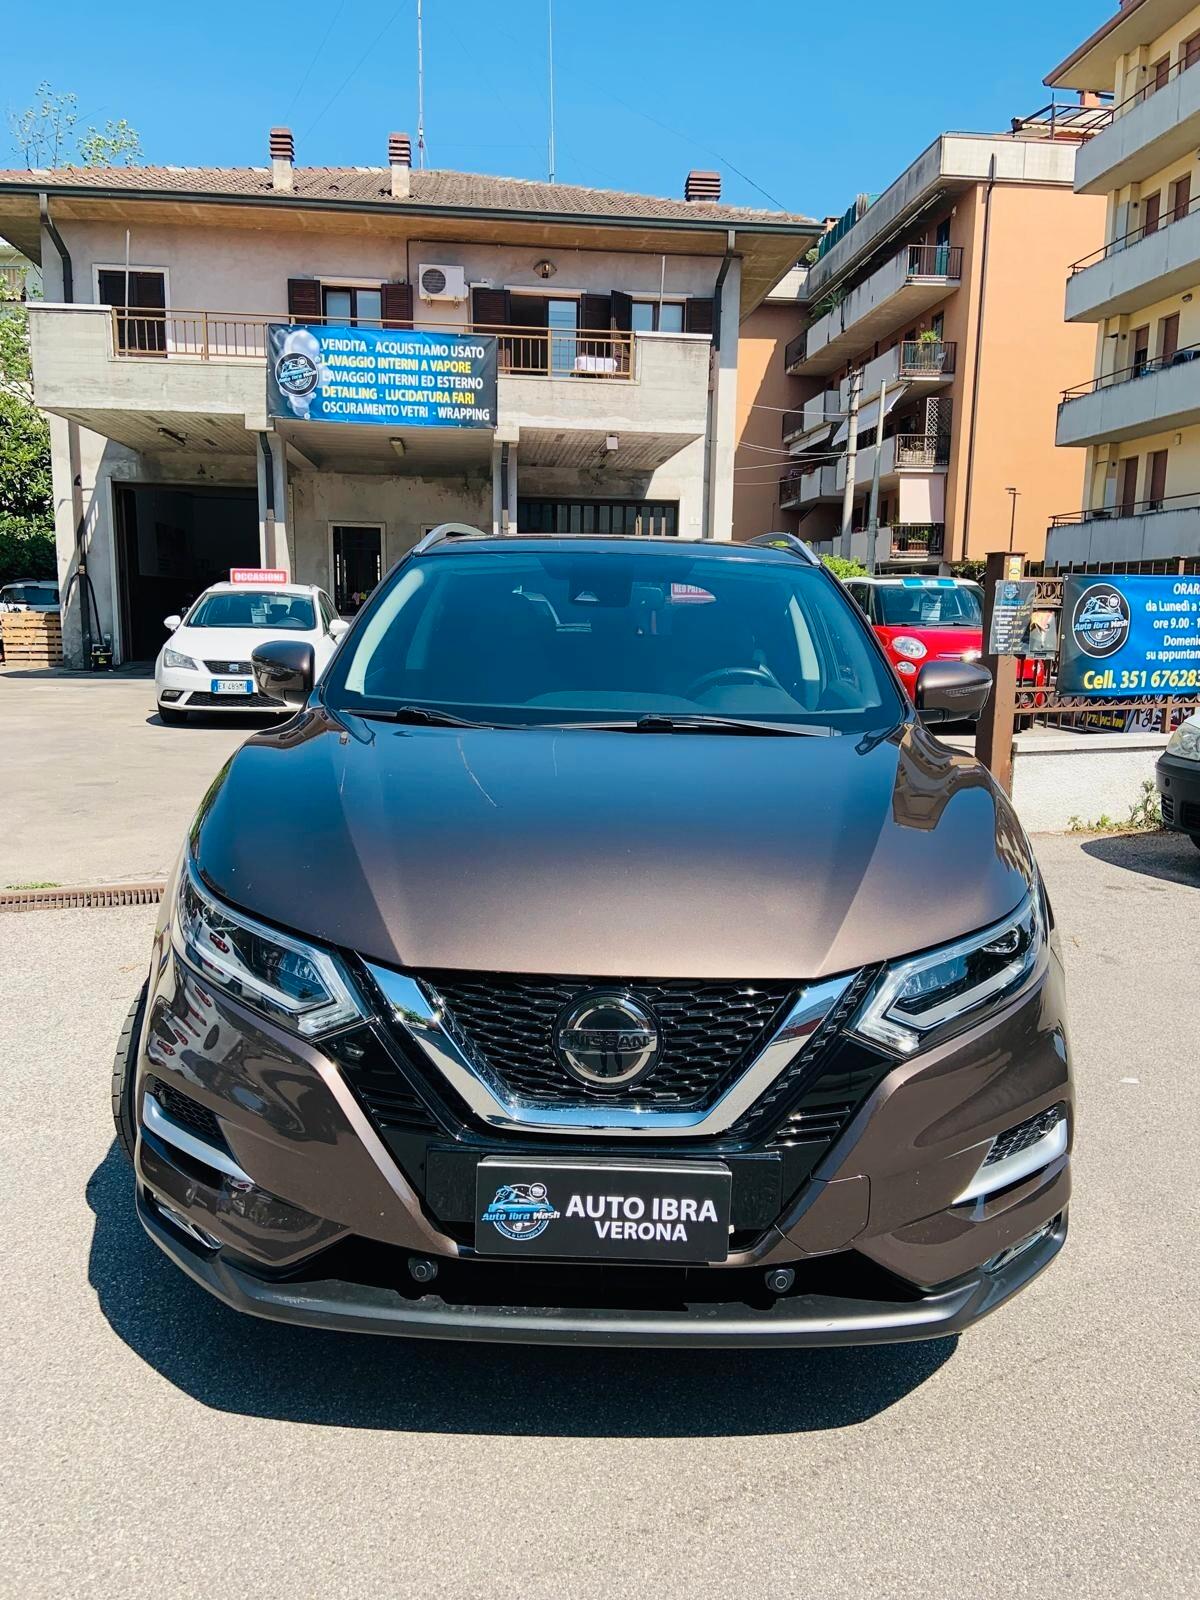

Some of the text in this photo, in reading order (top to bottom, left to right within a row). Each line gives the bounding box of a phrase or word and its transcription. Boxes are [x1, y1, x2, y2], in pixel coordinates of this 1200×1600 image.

[321, 338, 367, 352] VENDITA
[375, 341, 449, 357] ACQUISTIAMO
[450, 345, 485, 358] USATO
[321, 354, 472, 374] LAVAGGIO INTERNI A VAPORE
[322, 370, 484, 390] LAVAGGIO INTERNI ED ESTERNO
[322, 385, 378, 400] DETAILING
[385, 388, 450, 404] LUCIDATURA
[452, 392, 474, 404] FARI
[322, 401, 400, 416] OSCURAMENTO
[400, 405, 428, 418] VETRI
[437, 406, 490, 420] WRAPPING
[234, 572, 285, 582] OCCASIONE
[1173, 583, 1200, 595] ORAR
[1145, 600, 1157, 612] da
[1158, 600, 1190, 612] Lunedì
[1191, 603, 1197, 612] a
[1074, 622, 1092, 631] Auto
[1110, 619, 1128, 628] Wash
[1153, 620, 1168, 629] ore
[1170, 618, 1189, 629] 9.00
[1146, 651, 1156, 660] su
[1084, 670, 1117, 690] Cell.
[1120, 670, 1147, 688] 351
[481, 1210, 561, 1221] Auto Ibra Wash
[566, 1195, 718, 1223] AUTO IBRA
[594, 1220, 688, 1242] VERONA
